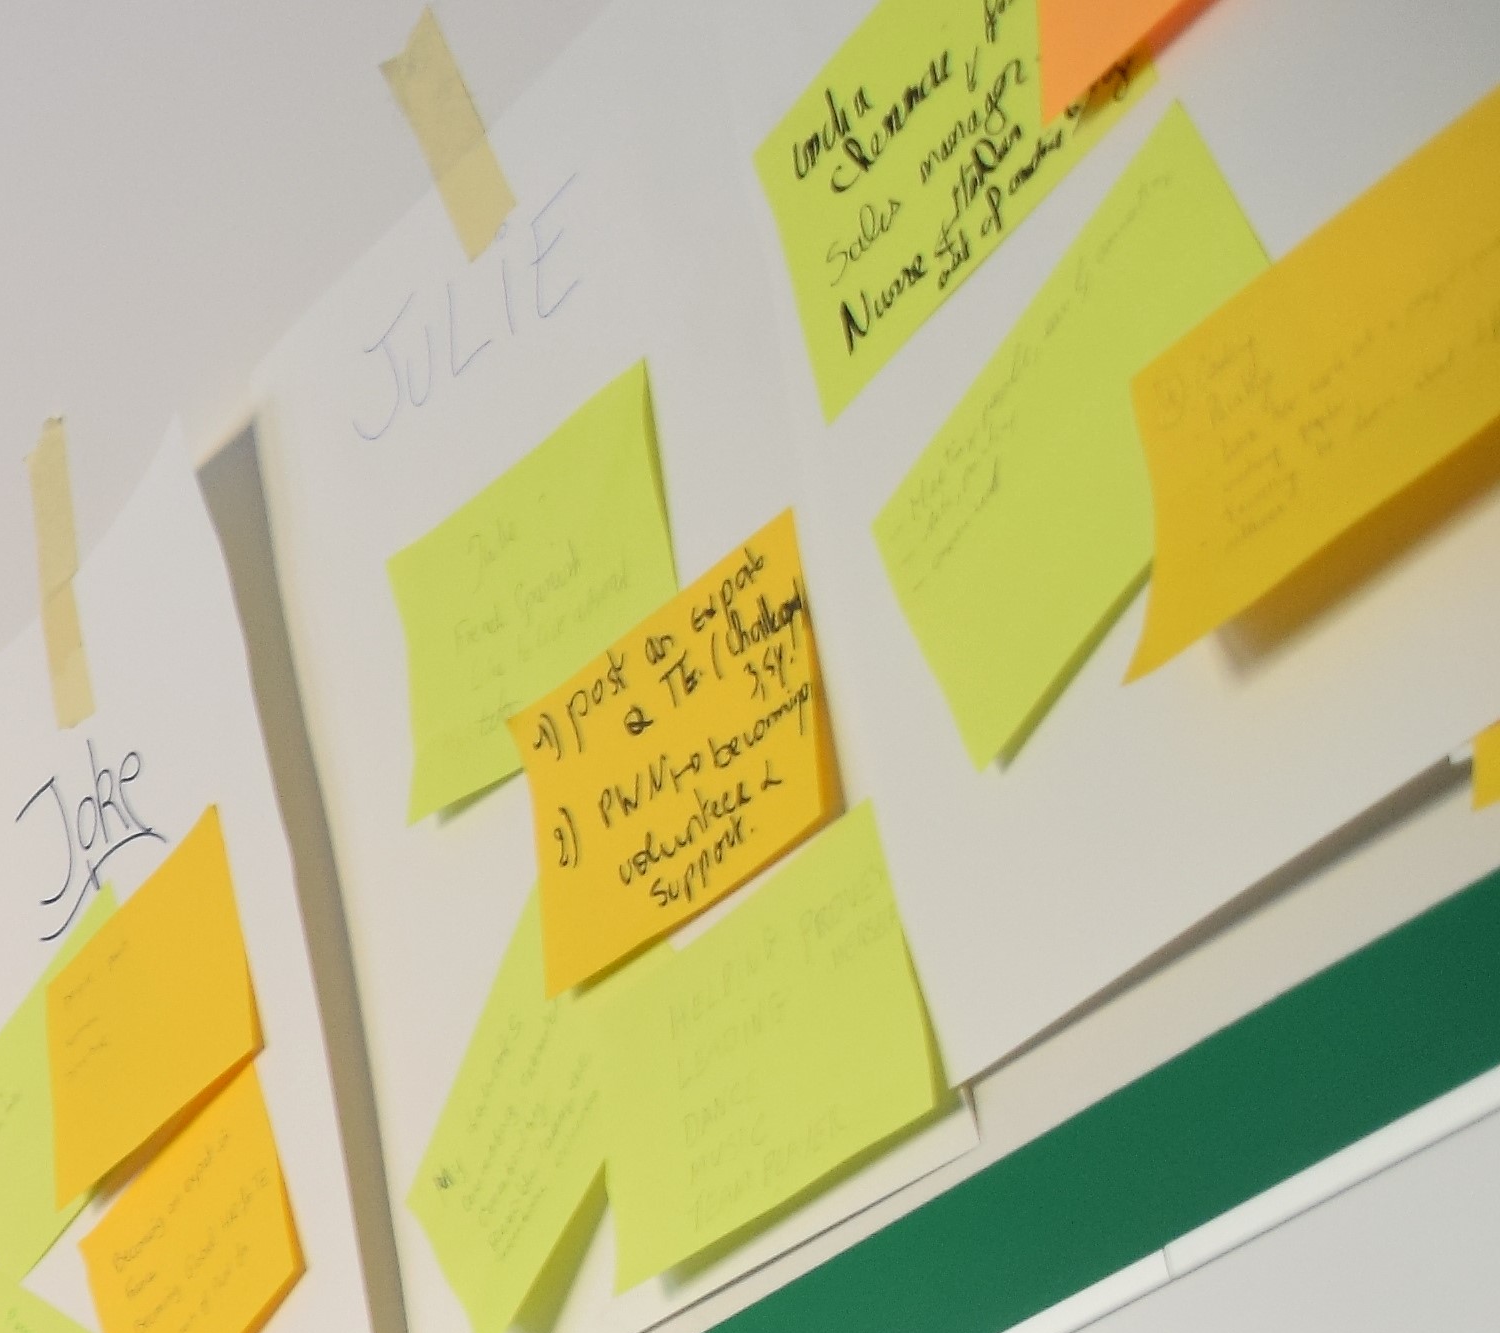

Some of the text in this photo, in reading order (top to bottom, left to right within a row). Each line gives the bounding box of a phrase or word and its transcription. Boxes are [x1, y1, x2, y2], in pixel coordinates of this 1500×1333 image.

[352, 172, 579, 441] JULIE
[826, 199, 901, 287] Sales
[15, 740, 155, 906] Joke
[599, 754, 667, 828] PWN
